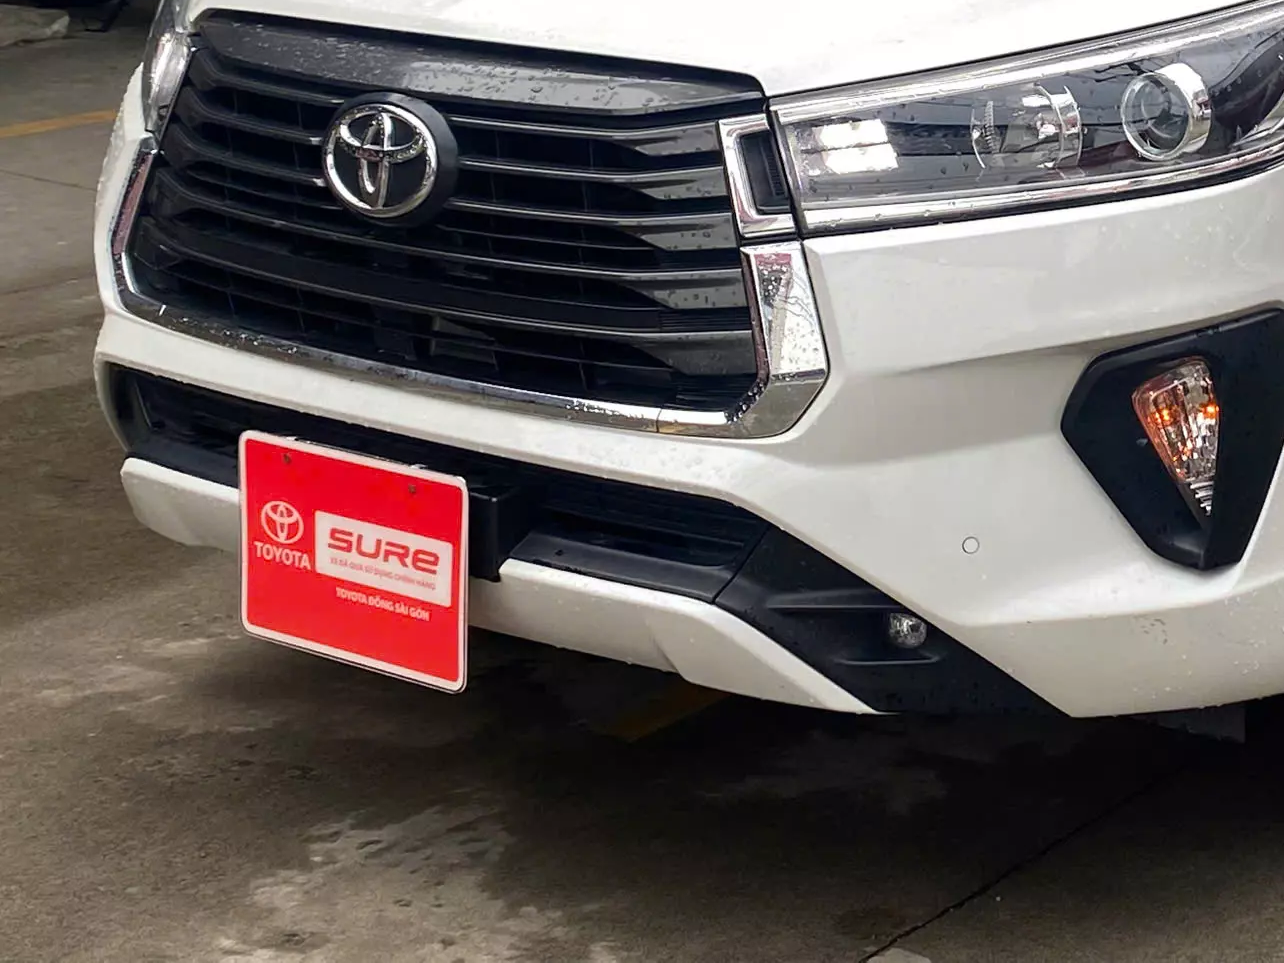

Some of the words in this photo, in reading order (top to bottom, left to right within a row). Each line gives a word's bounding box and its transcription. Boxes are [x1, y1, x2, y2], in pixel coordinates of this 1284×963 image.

[254, 541, 311, 571] TOYOTA
[336, 586, 368, 605] TOYOTA
[368, 595, 394, 612] ĐÔNG
[394, 601, 409, 616] SÀI
[409, 605, 430, 622] GÒN
